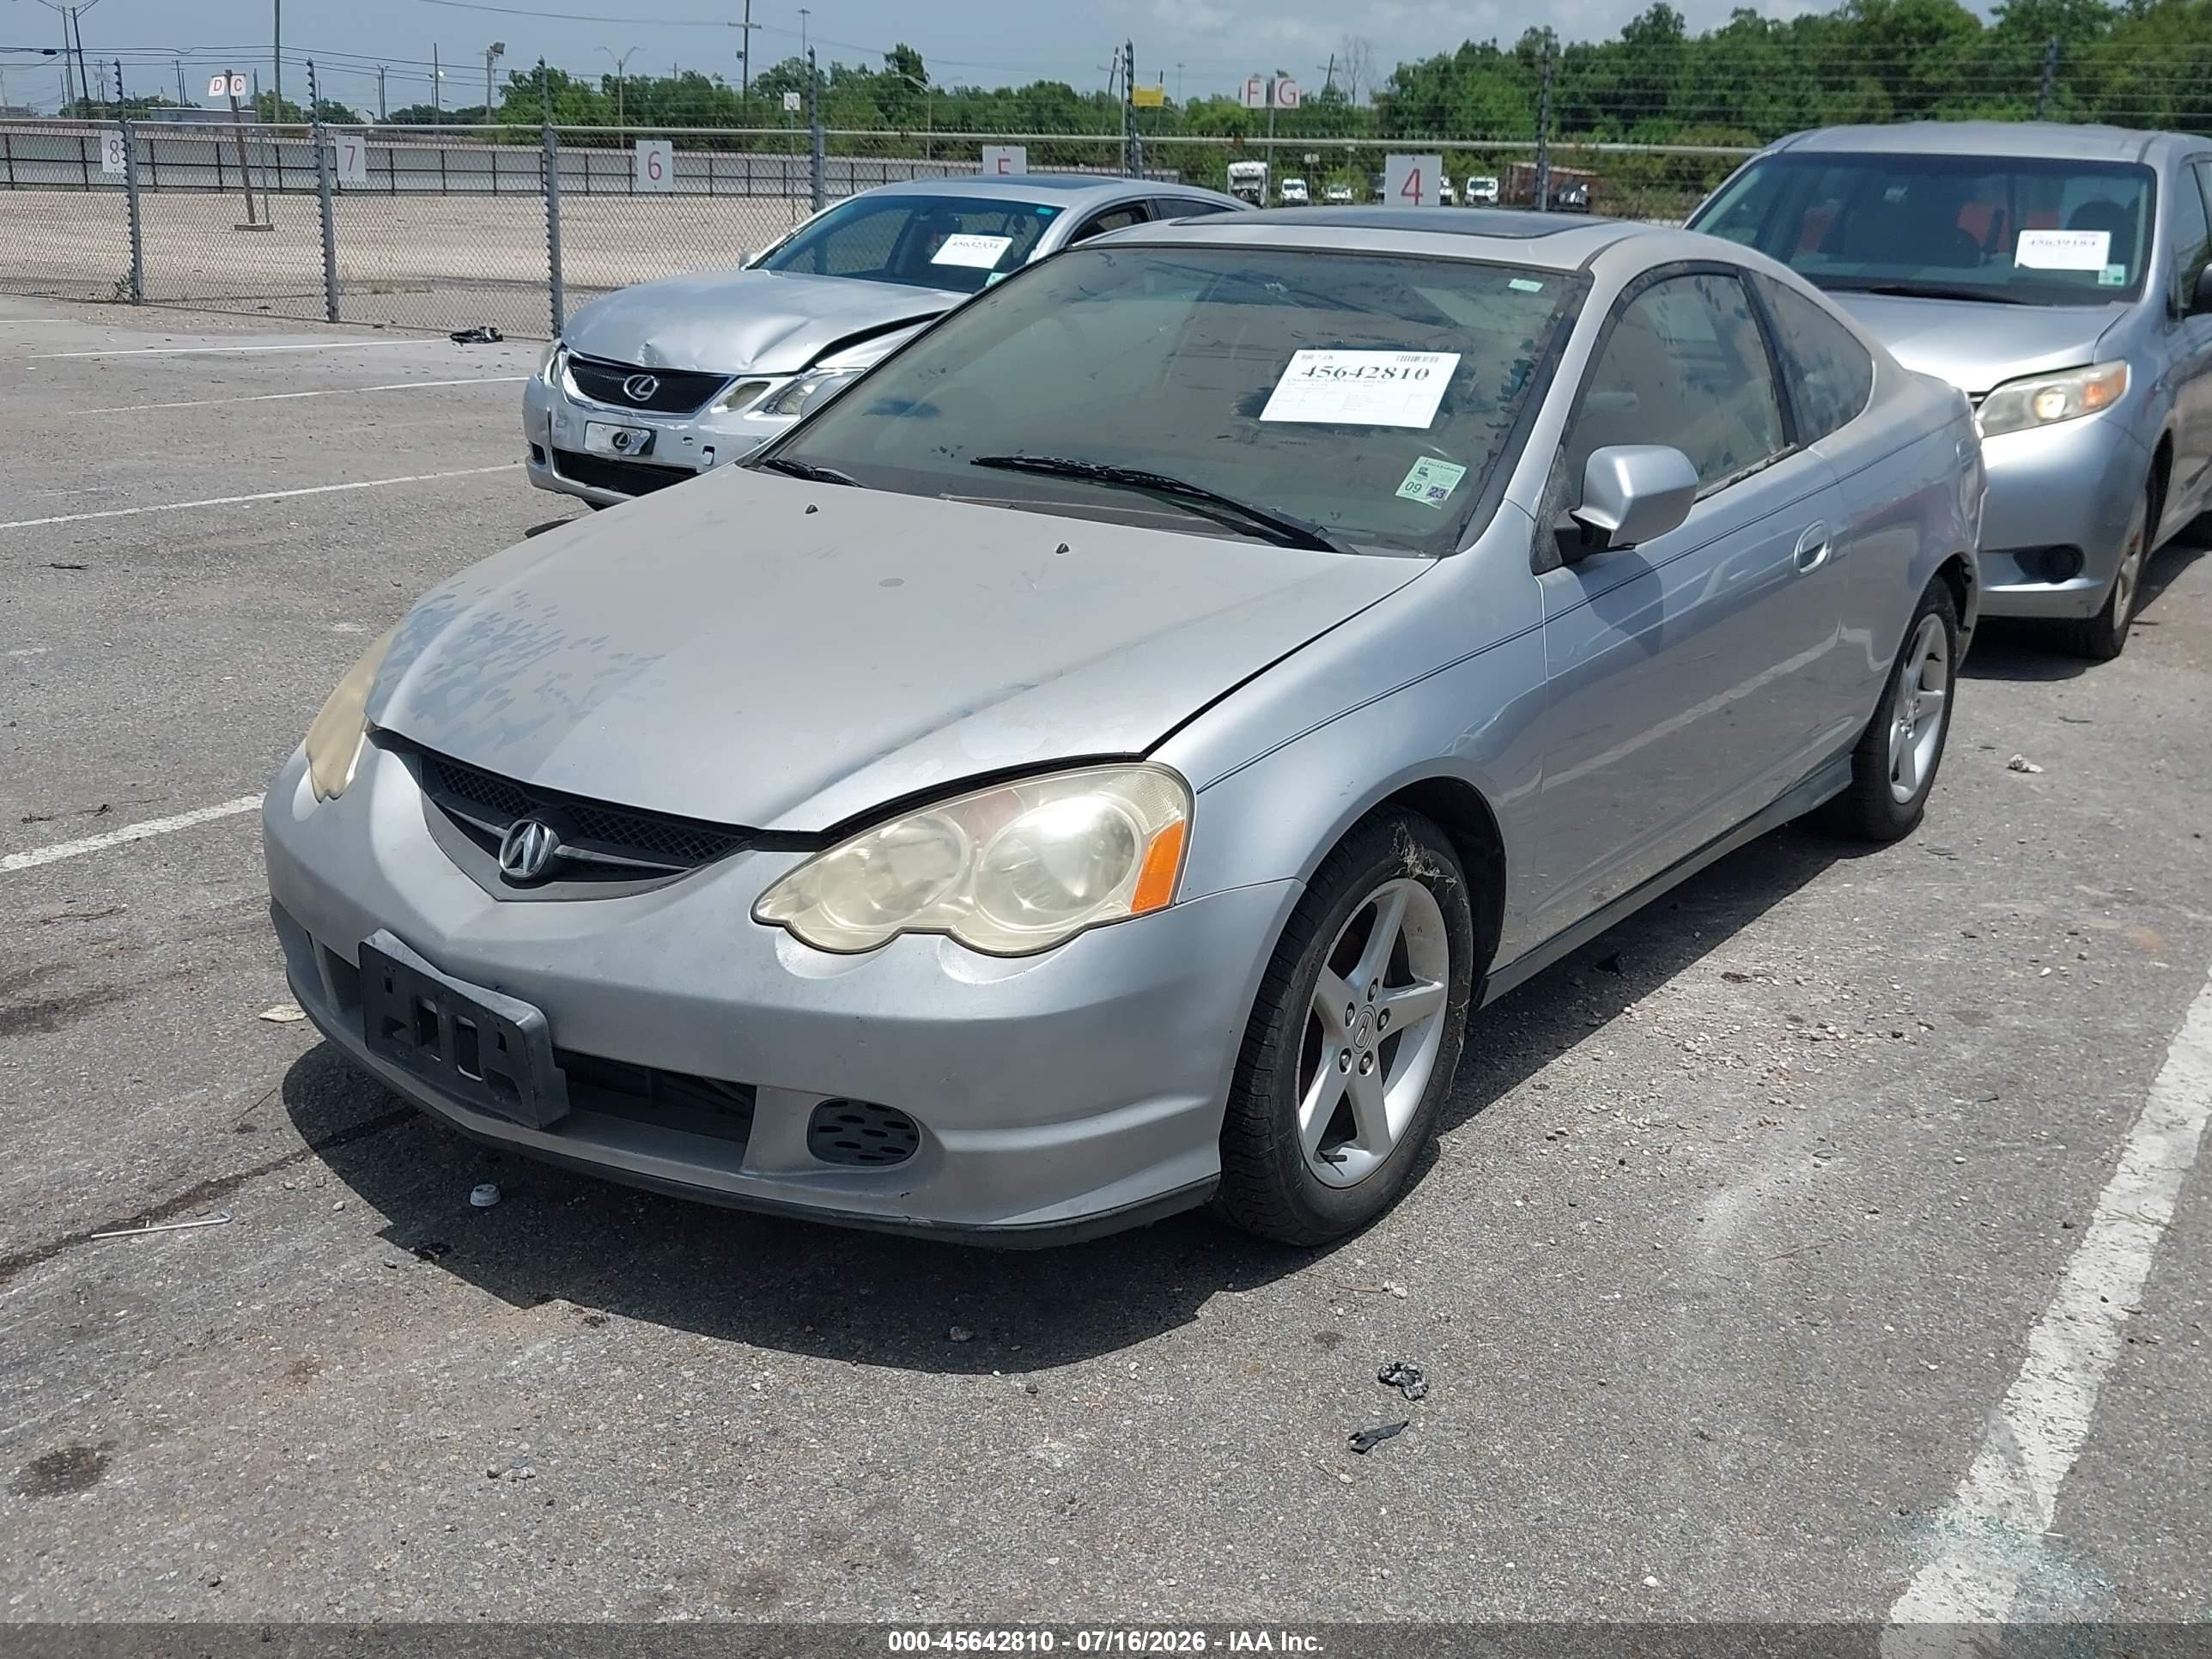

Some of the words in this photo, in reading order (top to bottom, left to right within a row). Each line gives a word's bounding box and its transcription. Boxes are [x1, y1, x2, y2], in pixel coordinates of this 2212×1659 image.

[213, 79, 222, 92] D
[234, 78, 242, 92] C
[1247, 79, 1260, 106] F
[1279, 79, 1296, 106] G
[109, 139, 120, 165] 8
[344, 144, 356, 172] 7
[647, 150, 662, 180] 6
[1401, 167, 1424, 206] 4
[1300, 364, 1430, 381] 45642810
[1404, 481, 1423, 494] 09
[1428, 486, 1446, 500] 23
